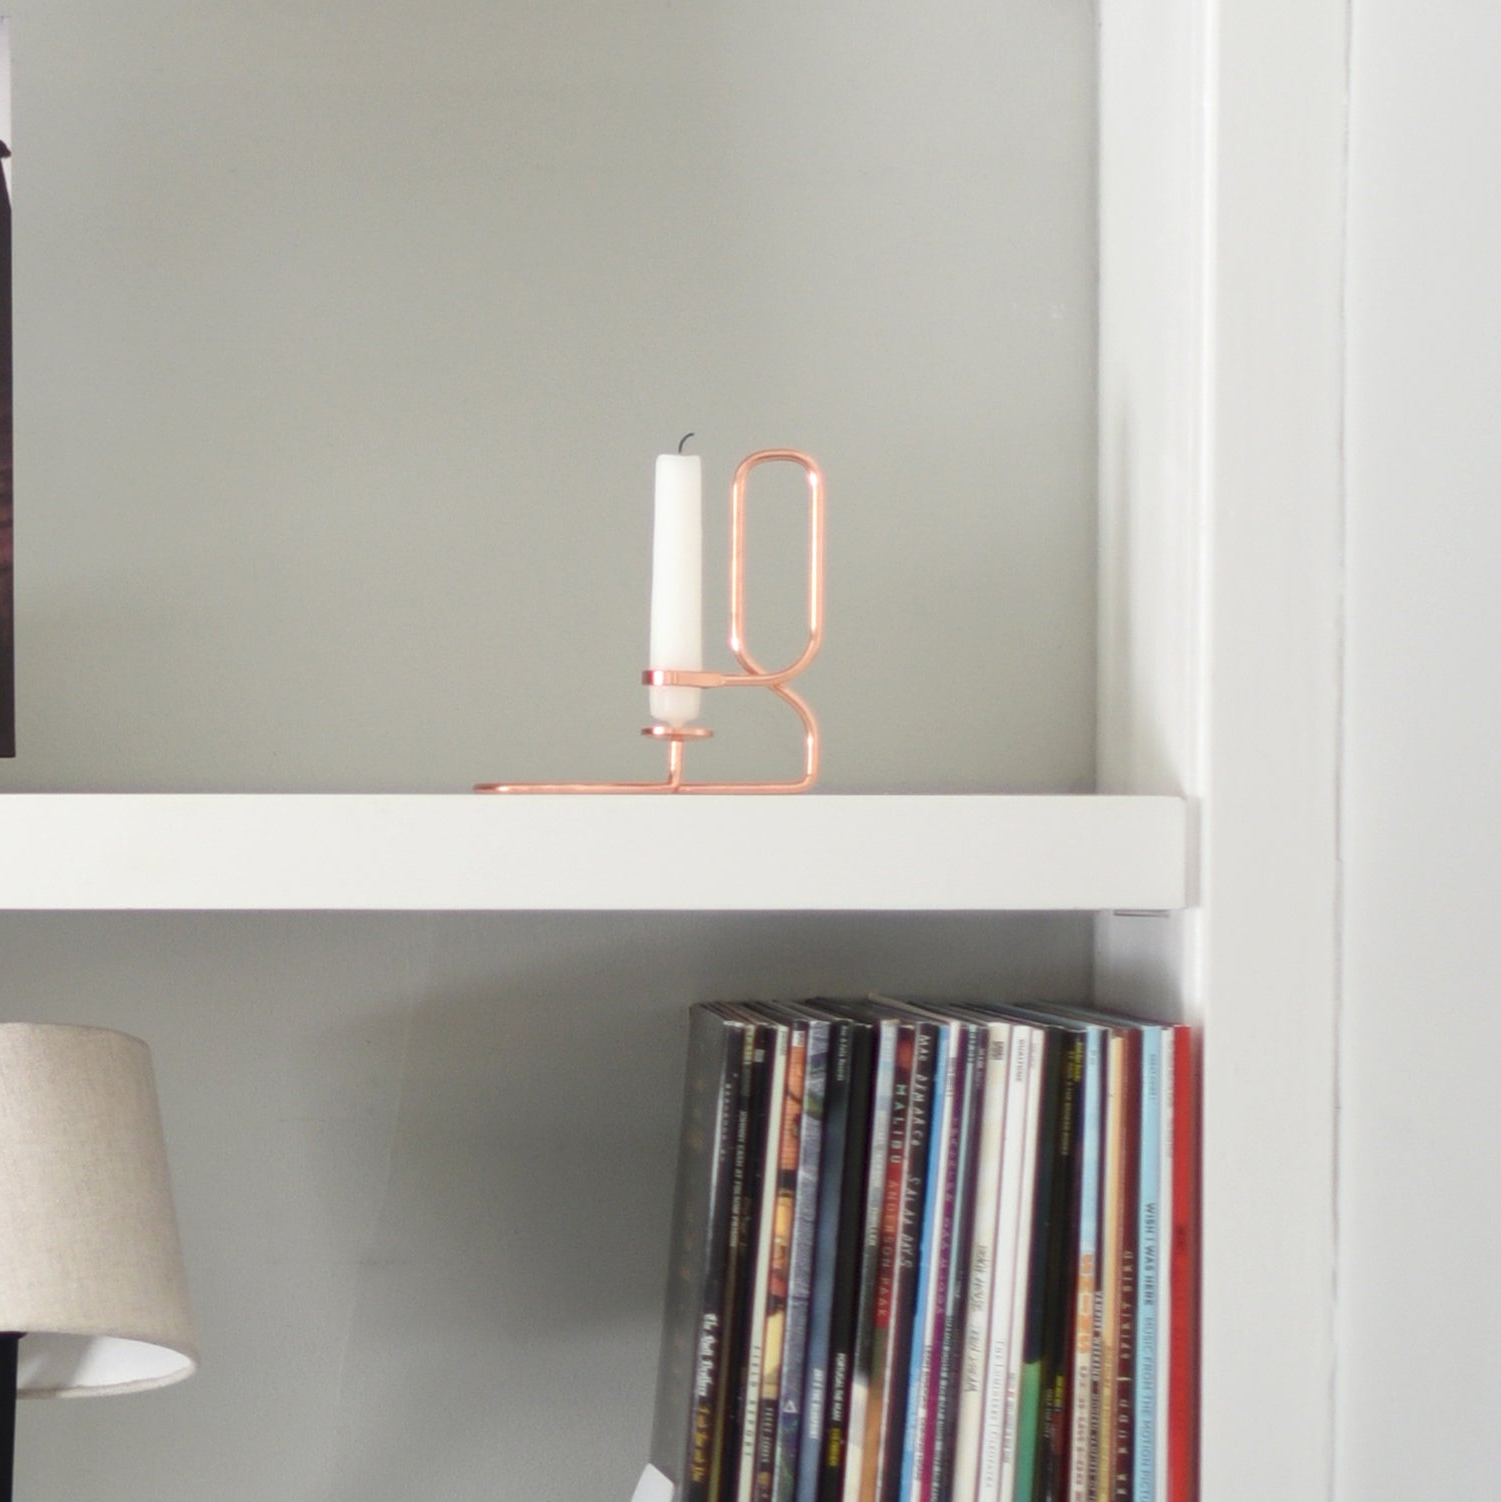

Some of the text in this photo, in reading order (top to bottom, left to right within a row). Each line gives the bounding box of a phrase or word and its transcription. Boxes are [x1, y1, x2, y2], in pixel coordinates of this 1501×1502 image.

[889, 1084, 906, 1163] MALIBU
[880, 1179, 899, 1267] ANDERSON
[1144, 1202, 1155, 1233] WISH
[1144, 1245, 1154, 1271] WAS
[1143, 1275, 1154, 1306] HERE
[1142, 1316, 1153, 1351] MUSIC
[1141, 1356, 1152, 1390] FROM
[1140, 1395, 1151, 1416] THE
[1139, 1419, 1151, 1465] MOTION
